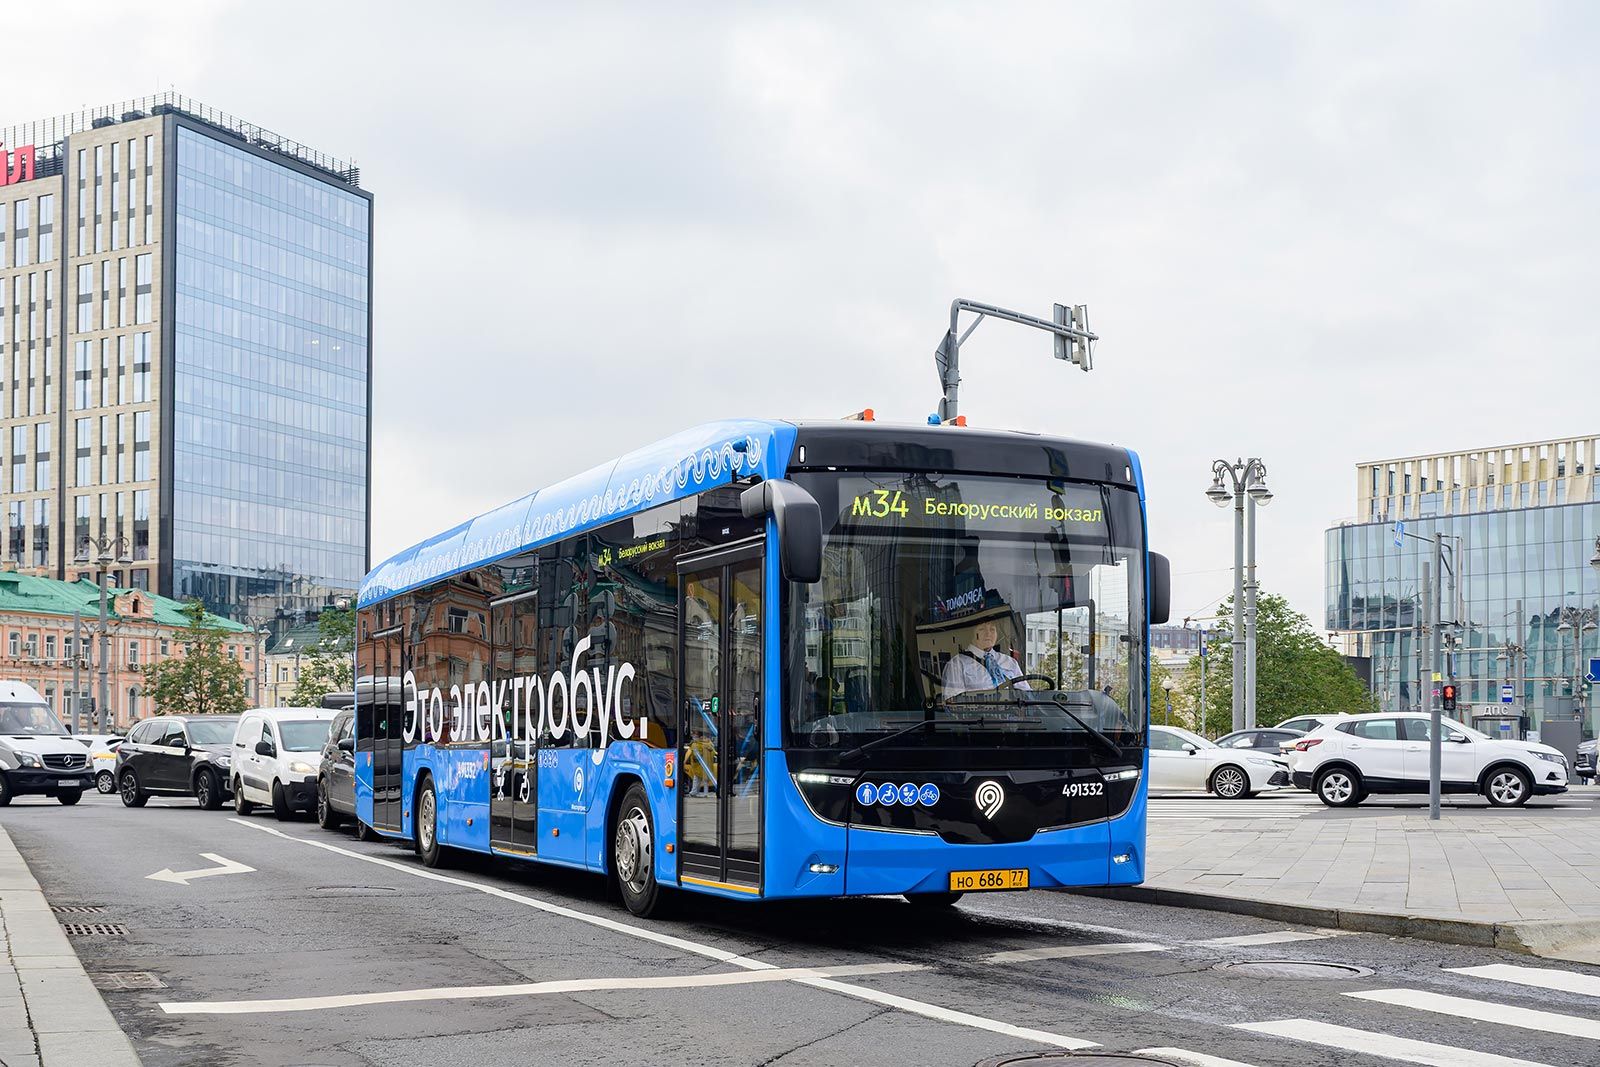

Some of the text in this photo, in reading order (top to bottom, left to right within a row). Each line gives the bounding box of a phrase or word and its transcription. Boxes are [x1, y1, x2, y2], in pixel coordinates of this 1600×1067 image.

[925, 497, 1038, 520] Белорусский
[1044, 507, 1102, 523] вокзал
[618, 541, 648, 558] Белорусский
[403, 634, 648, 766] Это электробус.
[1483, 706, 1508, 715] ДПС
[1062, 782, 1103, 797] 491332
[979, 872, 1004, 887] 686
[1011, 870, 1024, 882] 77
